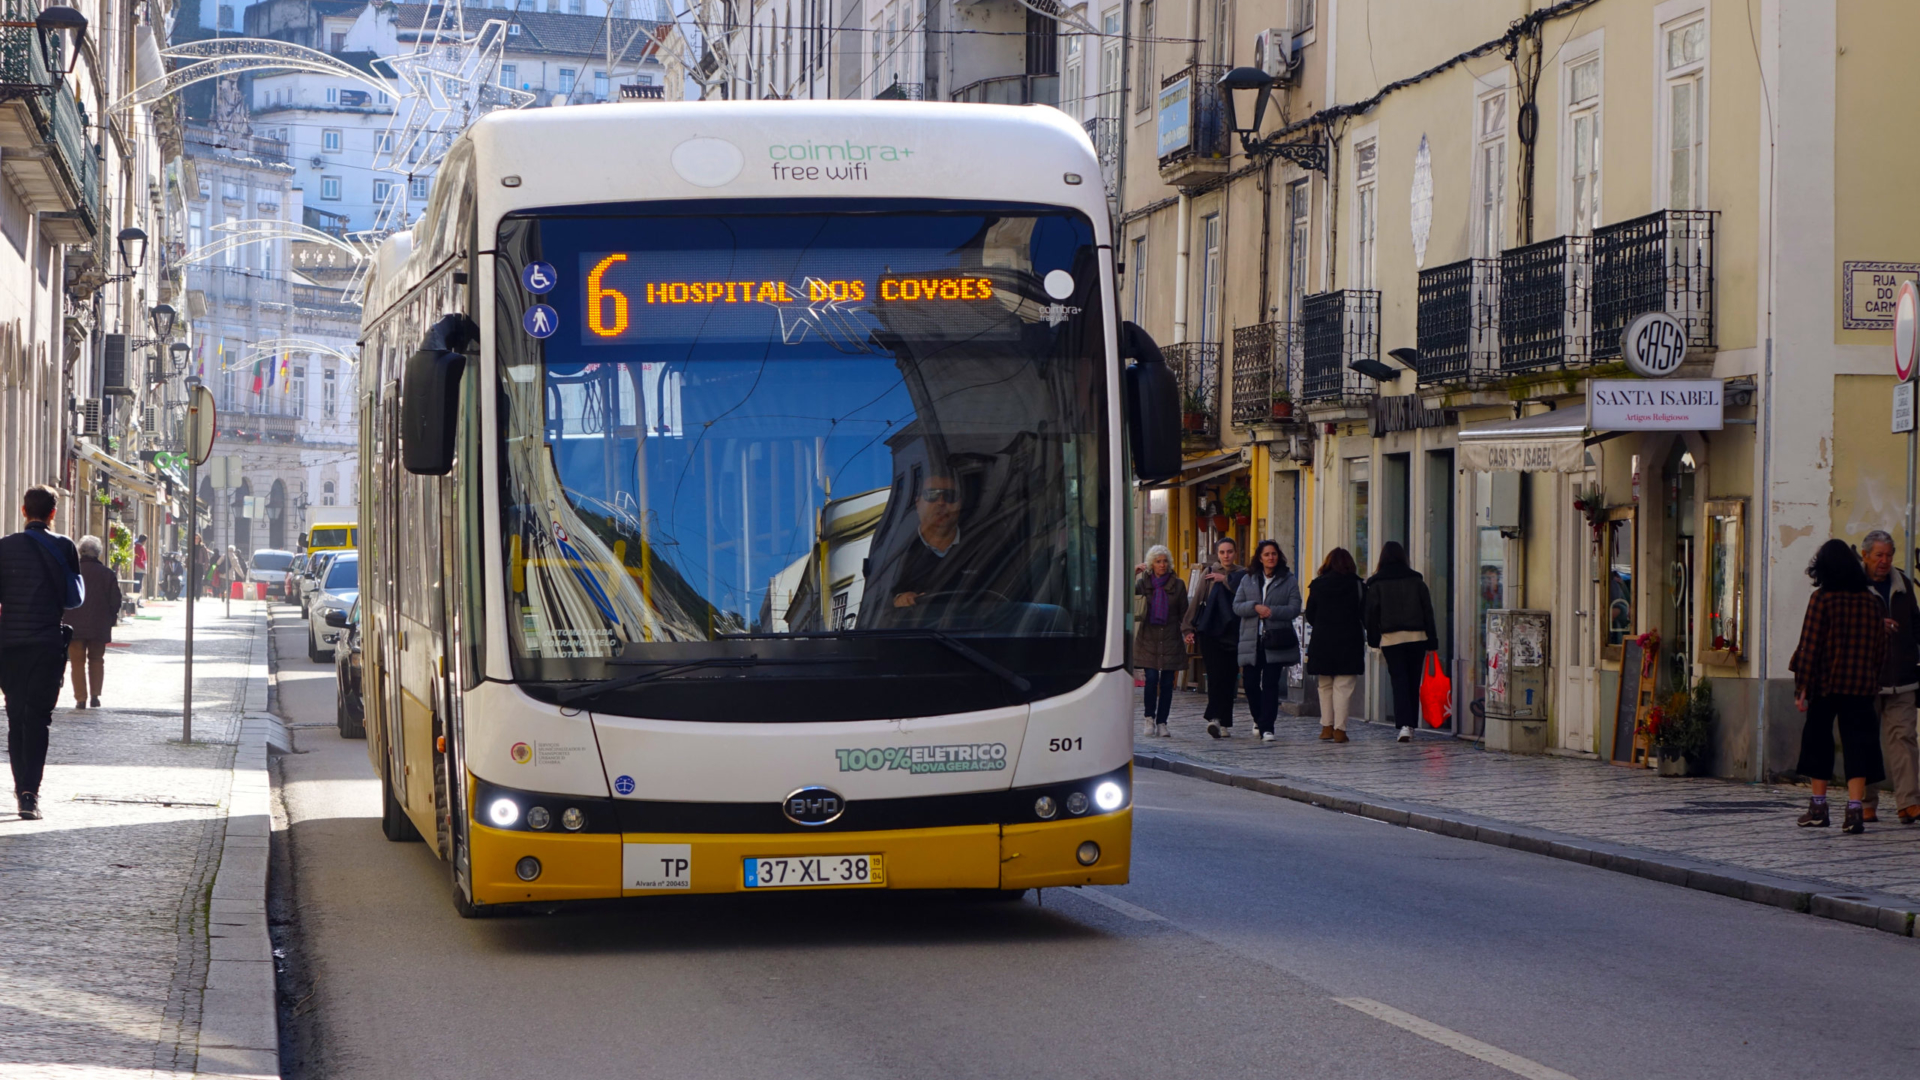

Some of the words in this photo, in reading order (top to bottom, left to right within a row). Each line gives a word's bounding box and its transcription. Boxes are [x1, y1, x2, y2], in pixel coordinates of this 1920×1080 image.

[769, 140, 914, 161] coimbra+
[771, 162, 819, 180] free
[826, 162, 868, 180] wifi
[1873, 274, 1897, 286] RUA
[588, 254, 628, 336] 6
[647, 281, 793, 303] HOSPITAL
[809, 280, 866, 302] DOS
[1877, 288, 1894, 300] DO
[1865, 301, 1897, 313] CARM
[1636, 320, 1683, 370] CASA
[1596, 390, 1655, 405] SANTA
[1660, 390, 1719, 405] ISABEL
[1625, 413, 1652, 423] Artigos
[1652, 413, 1690, 423] Religiosos
[1489, 447, 1508, 467] CASA
[1523, 447, 1552, 467] ISABEL
[1049, 737, 1082, 752] 501
[836, 747, 912, 771] 100%
[790, 798, 838, 815] BYD
[660, 858, 689, 877] TP
[872, 858, 881, 866] 19
[872, 872, 882, 881] 04
